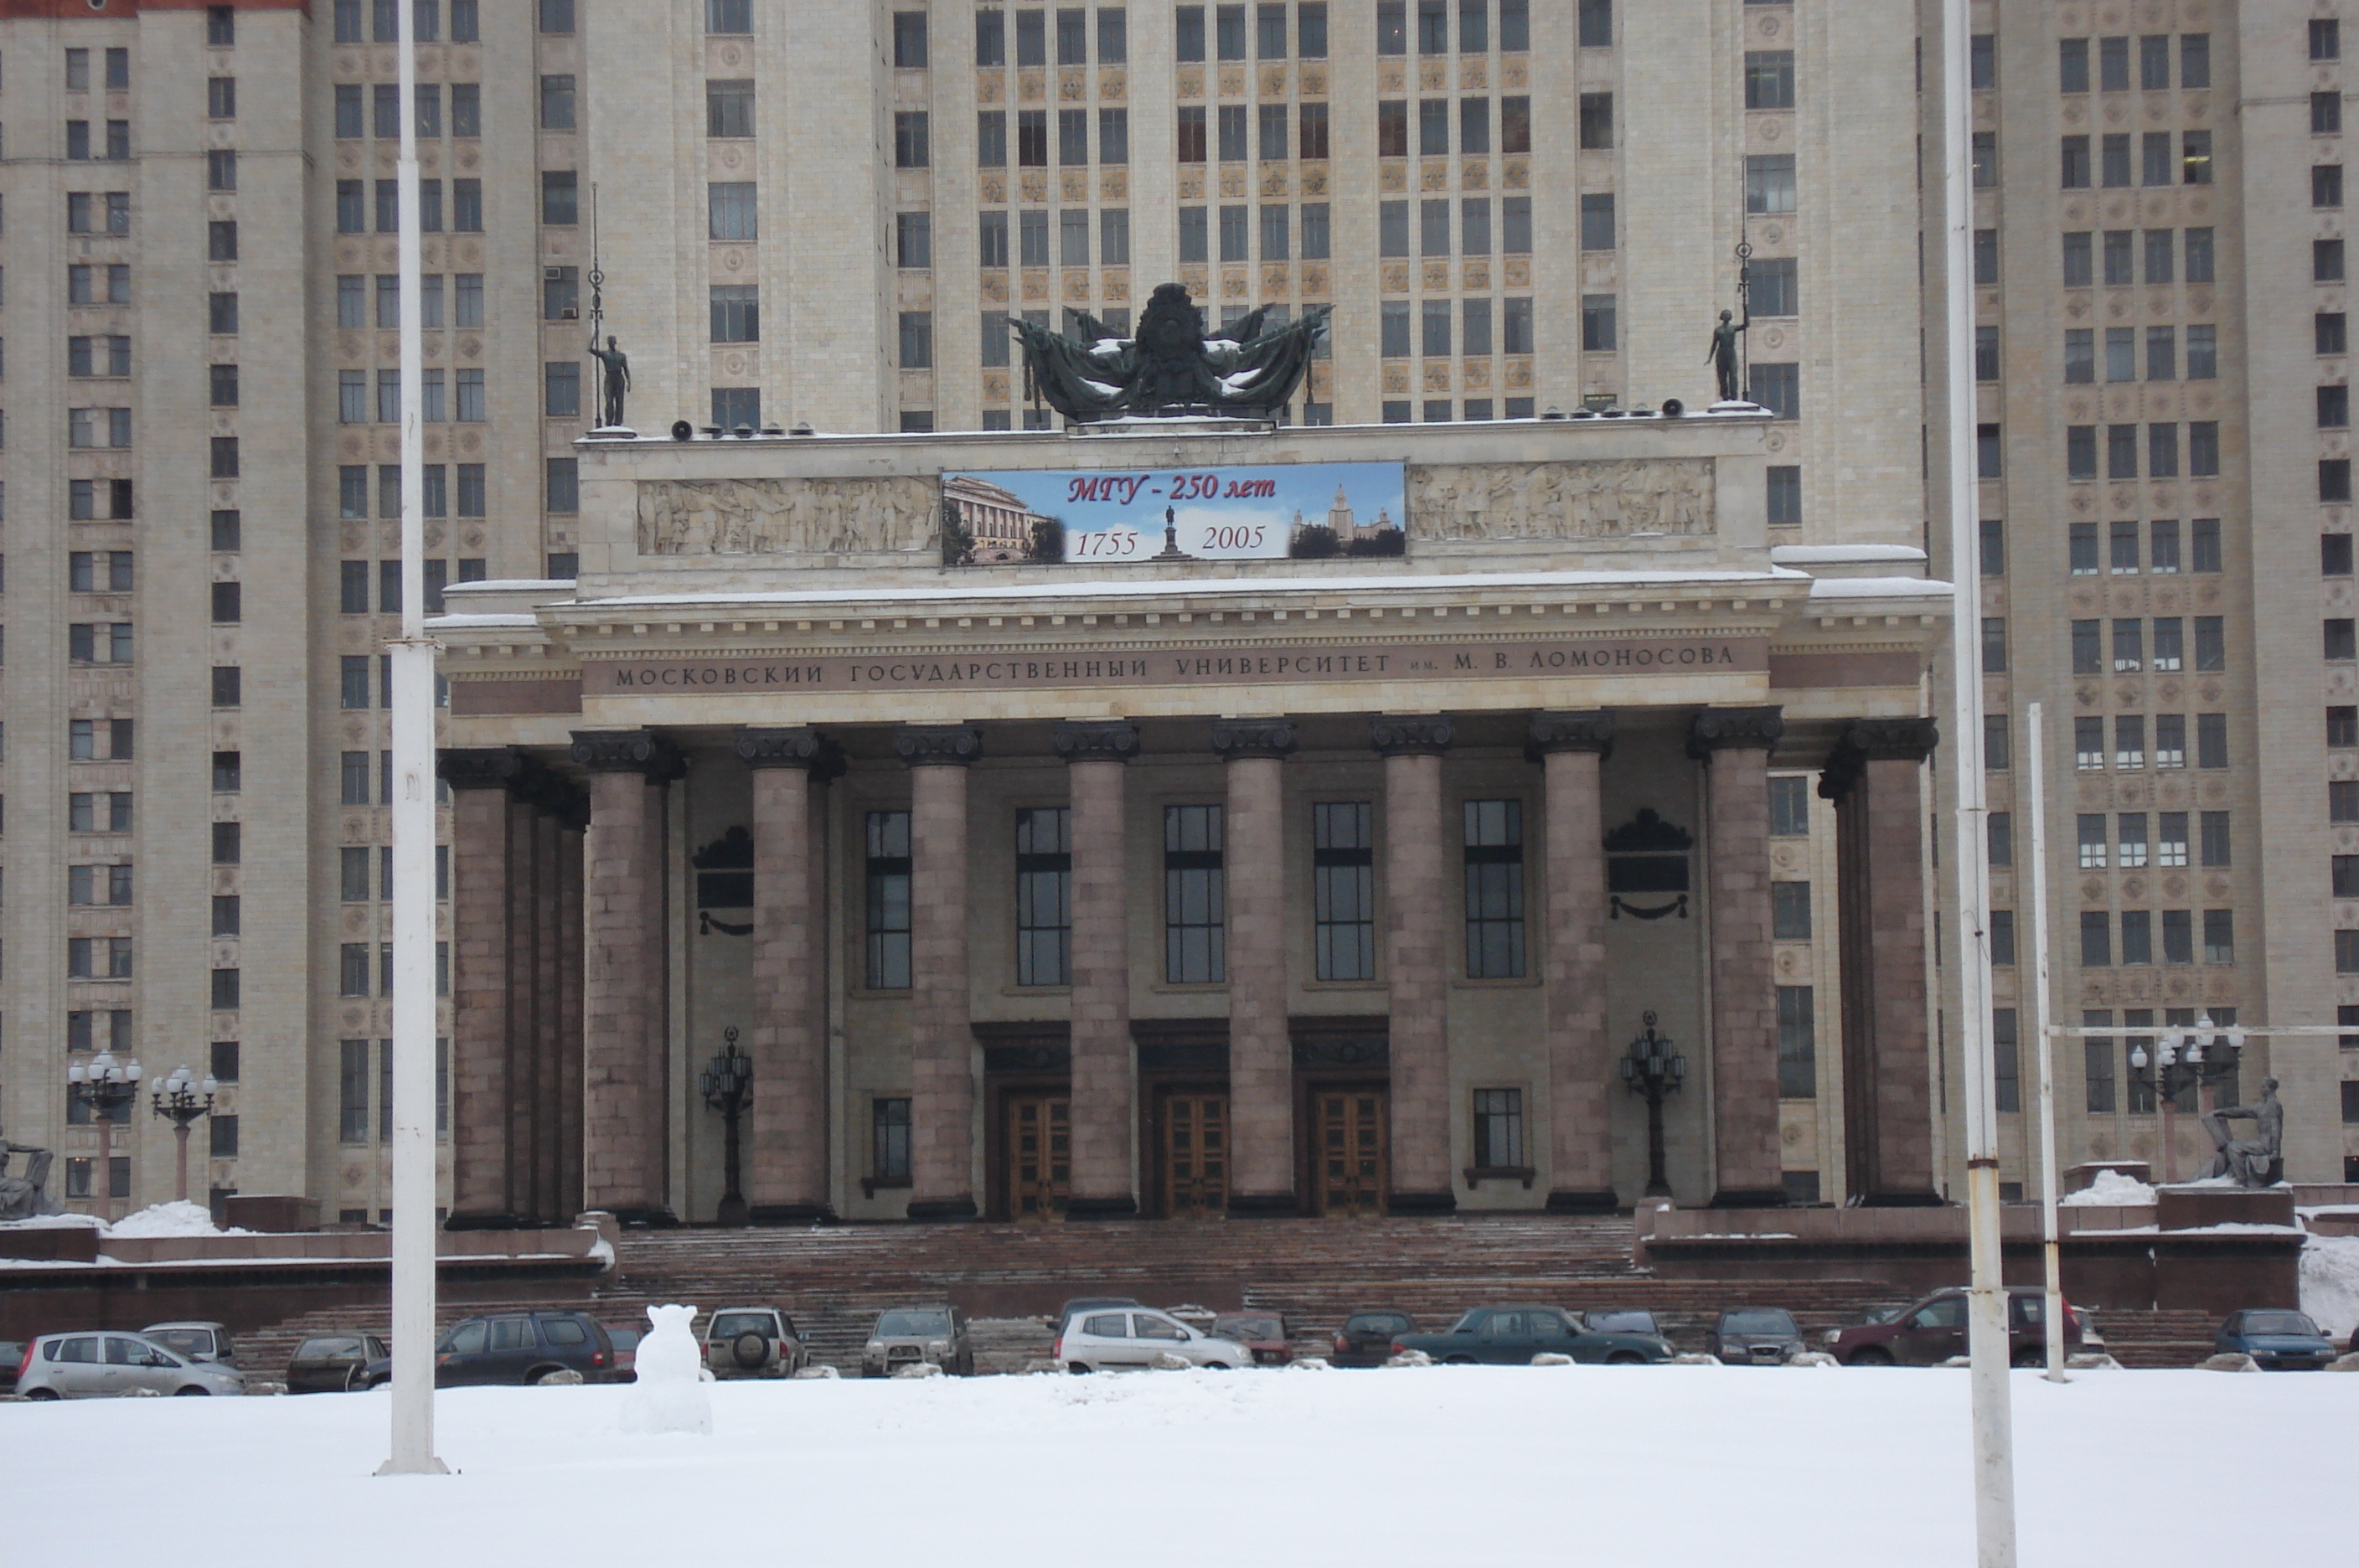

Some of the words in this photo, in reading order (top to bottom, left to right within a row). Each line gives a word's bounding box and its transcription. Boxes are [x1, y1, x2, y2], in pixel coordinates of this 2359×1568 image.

[1067, 474, 1150, 505] МГУ
[1169, 474, 1218, 500] 250
[1223, 477, 1276, 499] лет
[1076, 531, 1138, 556] 1755
[1202, 525, 1267, 549] 2005
[616, 664, 823, 686] МОСКОВСКИЙ
[850, 658, 1148, 682] ГОСУДАРСТВЕННЫЙ
[1176, 655, 1390, 675] УНИВЕРСИТЕТ
[1454, 653, 1478, 670] М.
[1494, 652, 1513, 669] В.
[1530, 646, 1733, 668] ЛОМОНОСОВА
